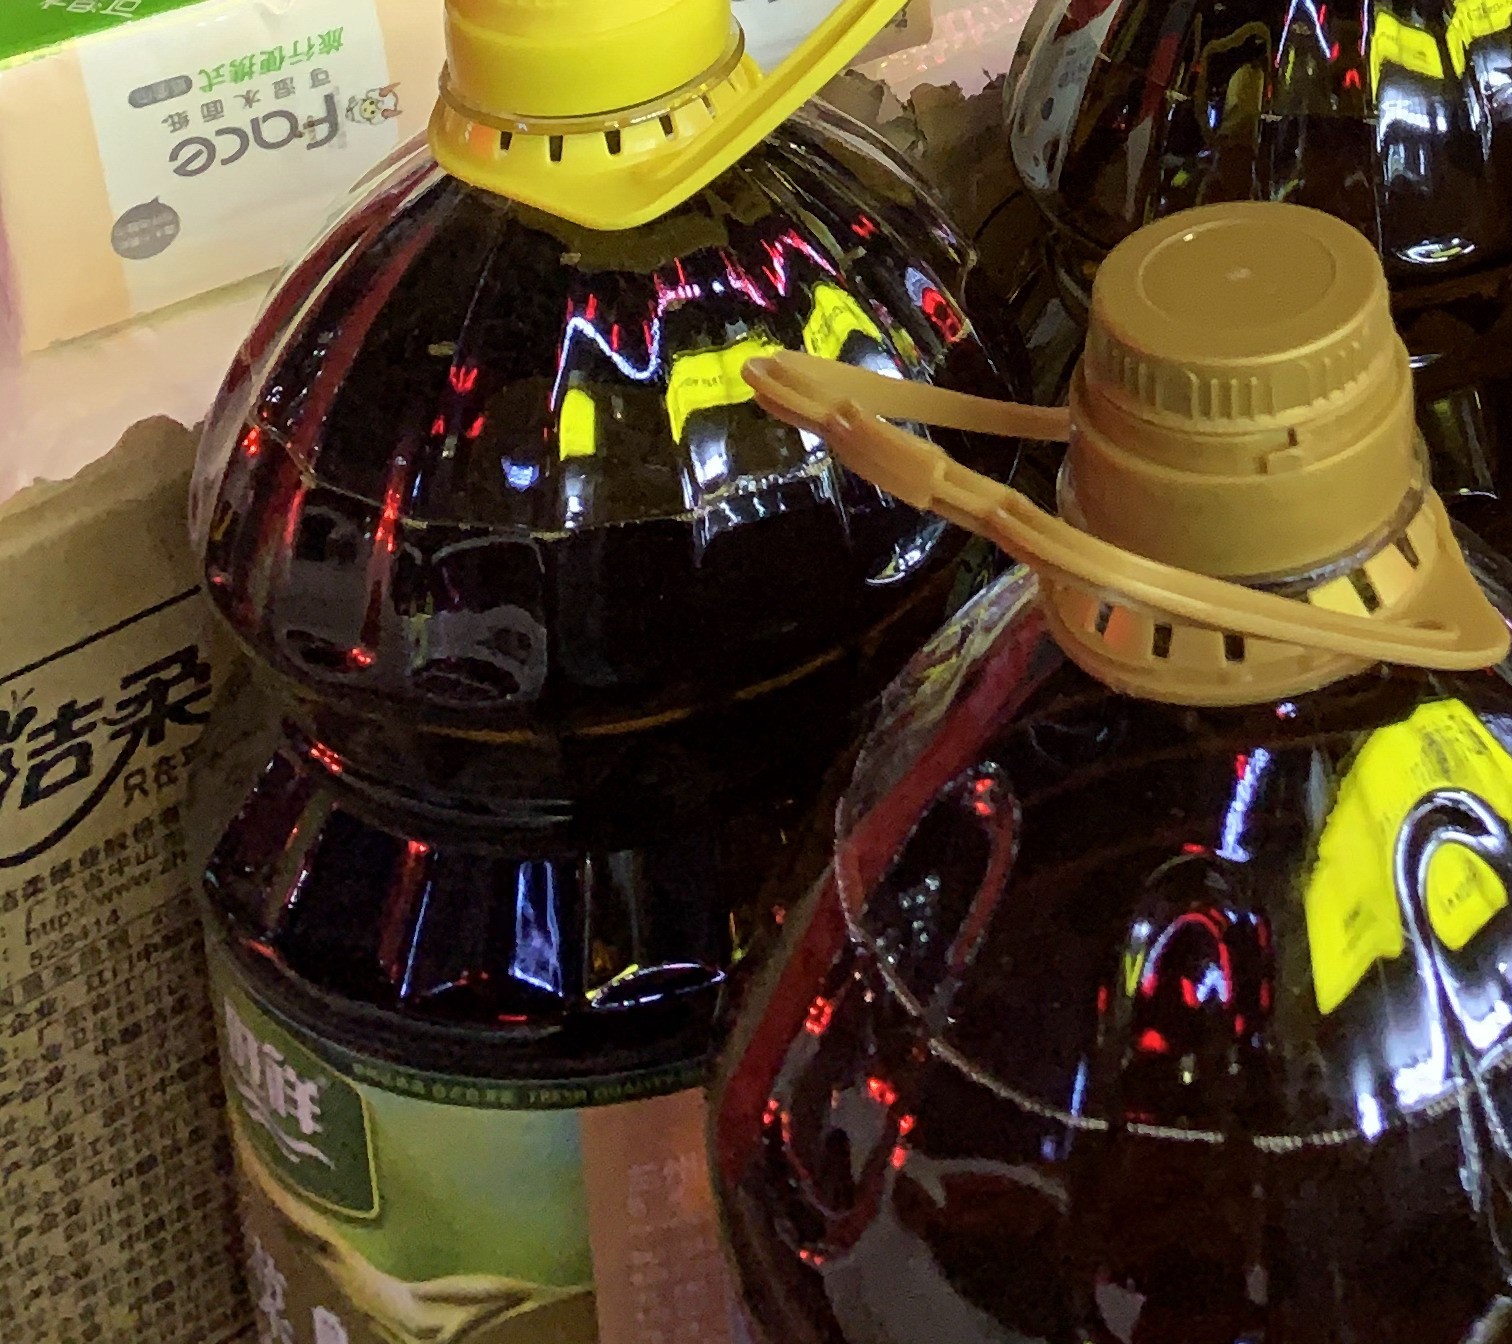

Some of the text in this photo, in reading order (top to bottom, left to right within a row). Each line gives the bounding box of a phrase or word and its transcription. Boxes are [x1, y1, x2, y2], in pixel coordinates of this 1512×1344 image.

[197, 26, 345, 94] 旅行便携式
[168, 93, 341, 179] Face
